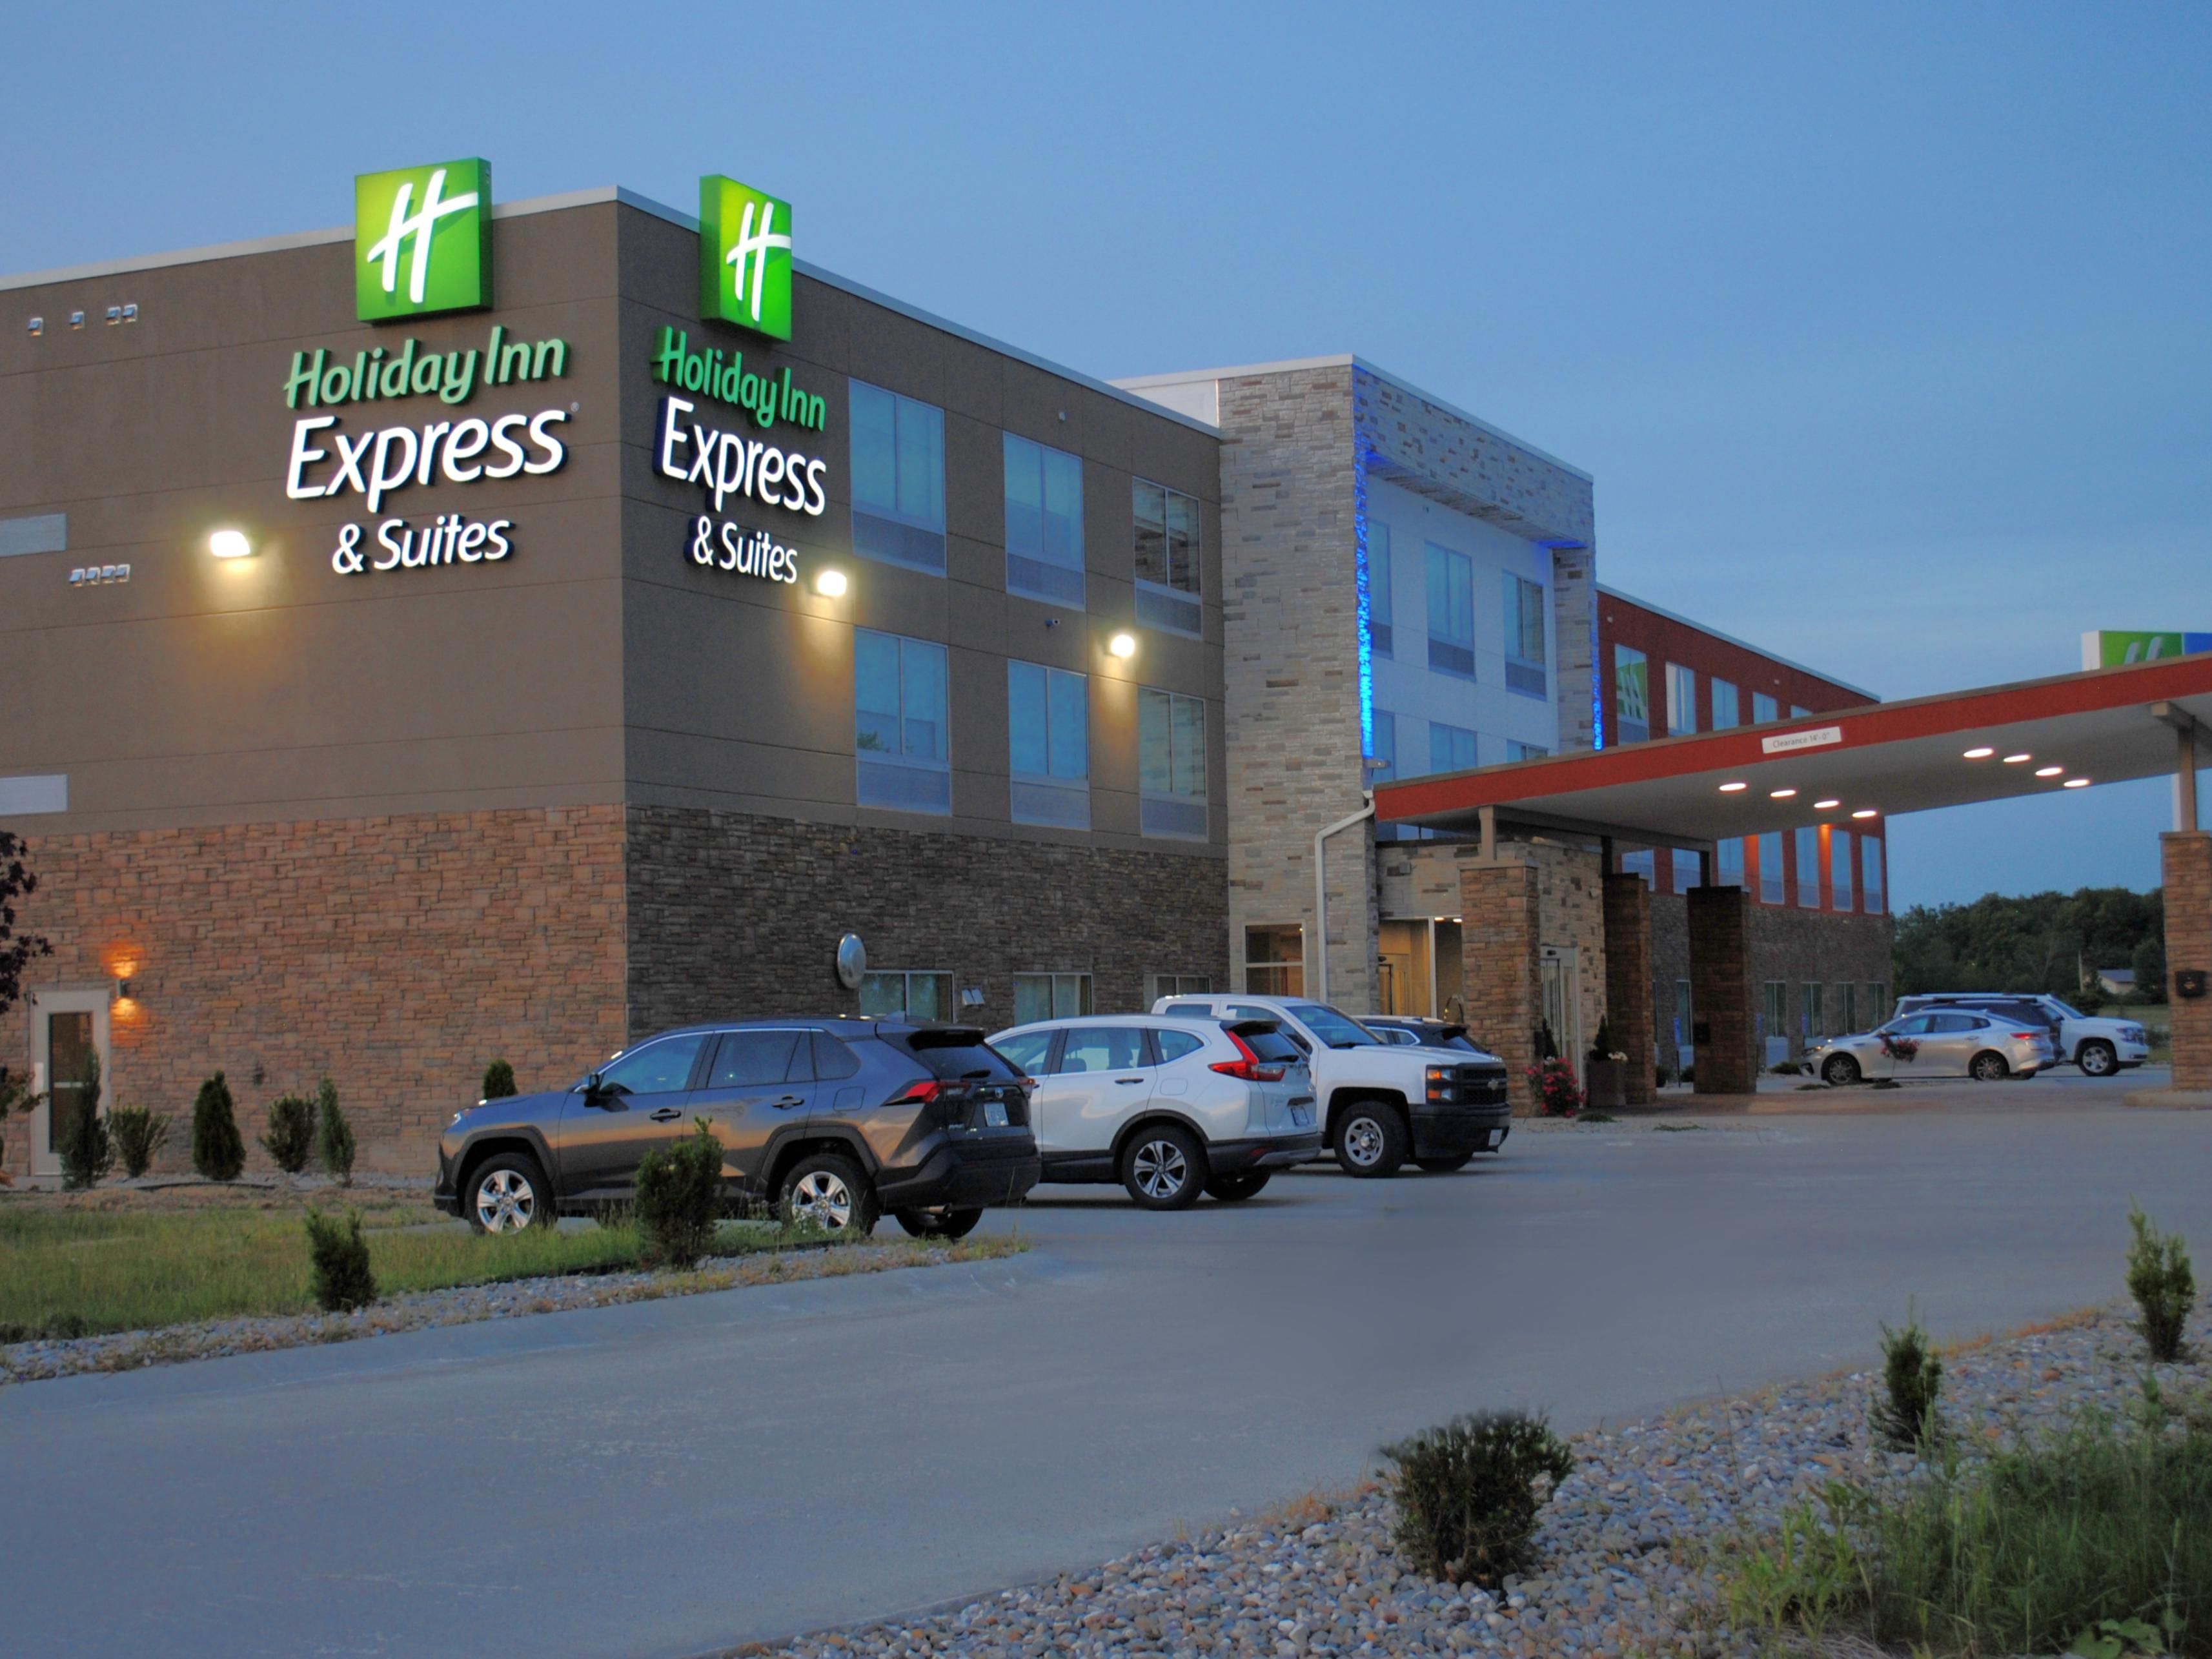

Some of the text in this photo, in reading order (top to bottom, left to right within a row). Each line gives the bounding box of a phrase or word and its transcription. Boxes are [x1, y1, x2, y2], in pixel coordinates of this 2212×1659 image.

[283, 325, 569, 408] Holiday Inn
[653, 325, 826, 432] Holiday Inn
[286, 409, 567, 514] Express
[660, 395, 827, 516] Express
[332, 514, 512, 575] & Suites
[693, 515, 798, 584] & Suites
[1772, 737, 1808, 748] Clearance
